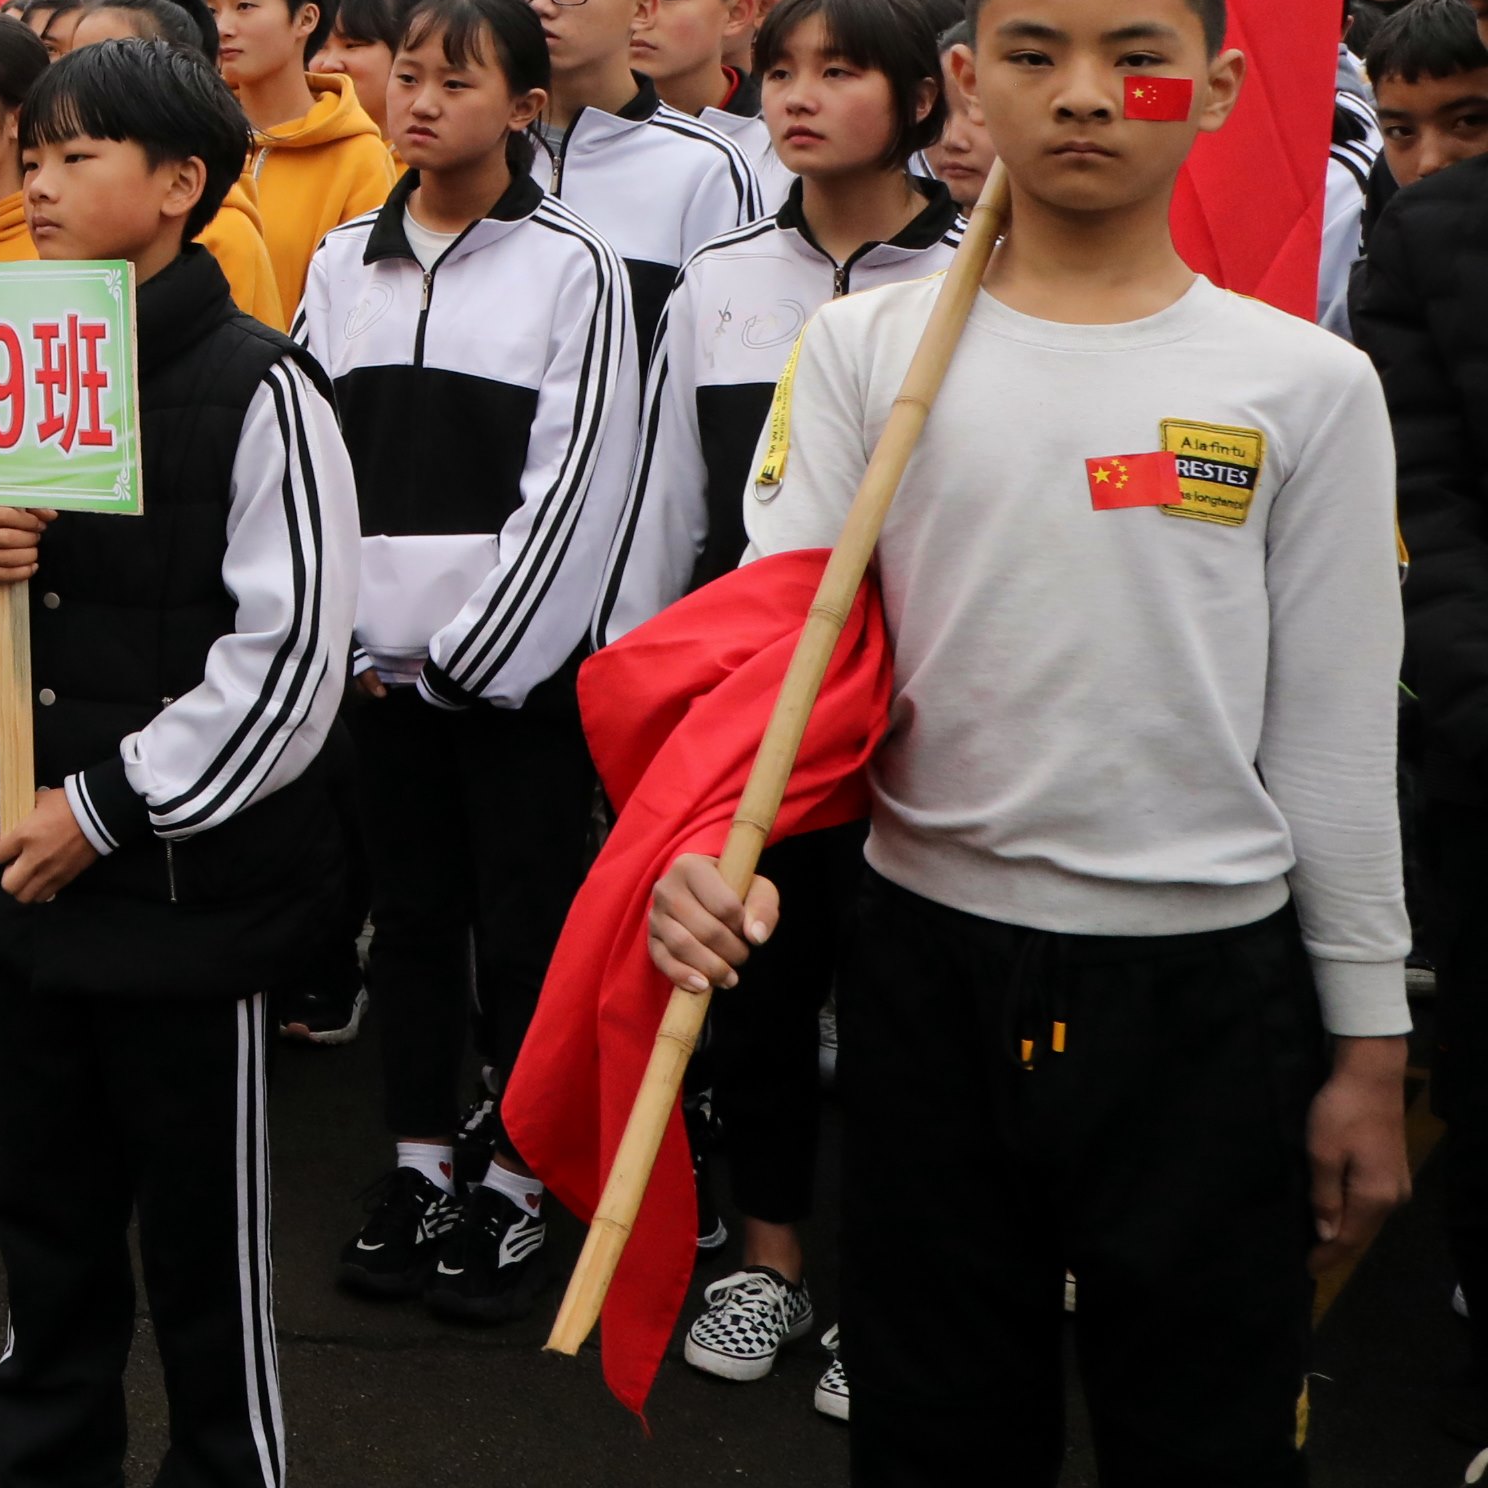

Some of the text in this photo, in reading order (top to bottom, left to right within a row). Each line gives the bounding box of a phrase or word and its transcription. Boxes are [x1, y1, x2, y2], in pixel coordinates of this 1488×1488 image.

[1181, 437, 1246, 458] A la fin tu
[1175, 459, 1250, 485] RESTES
